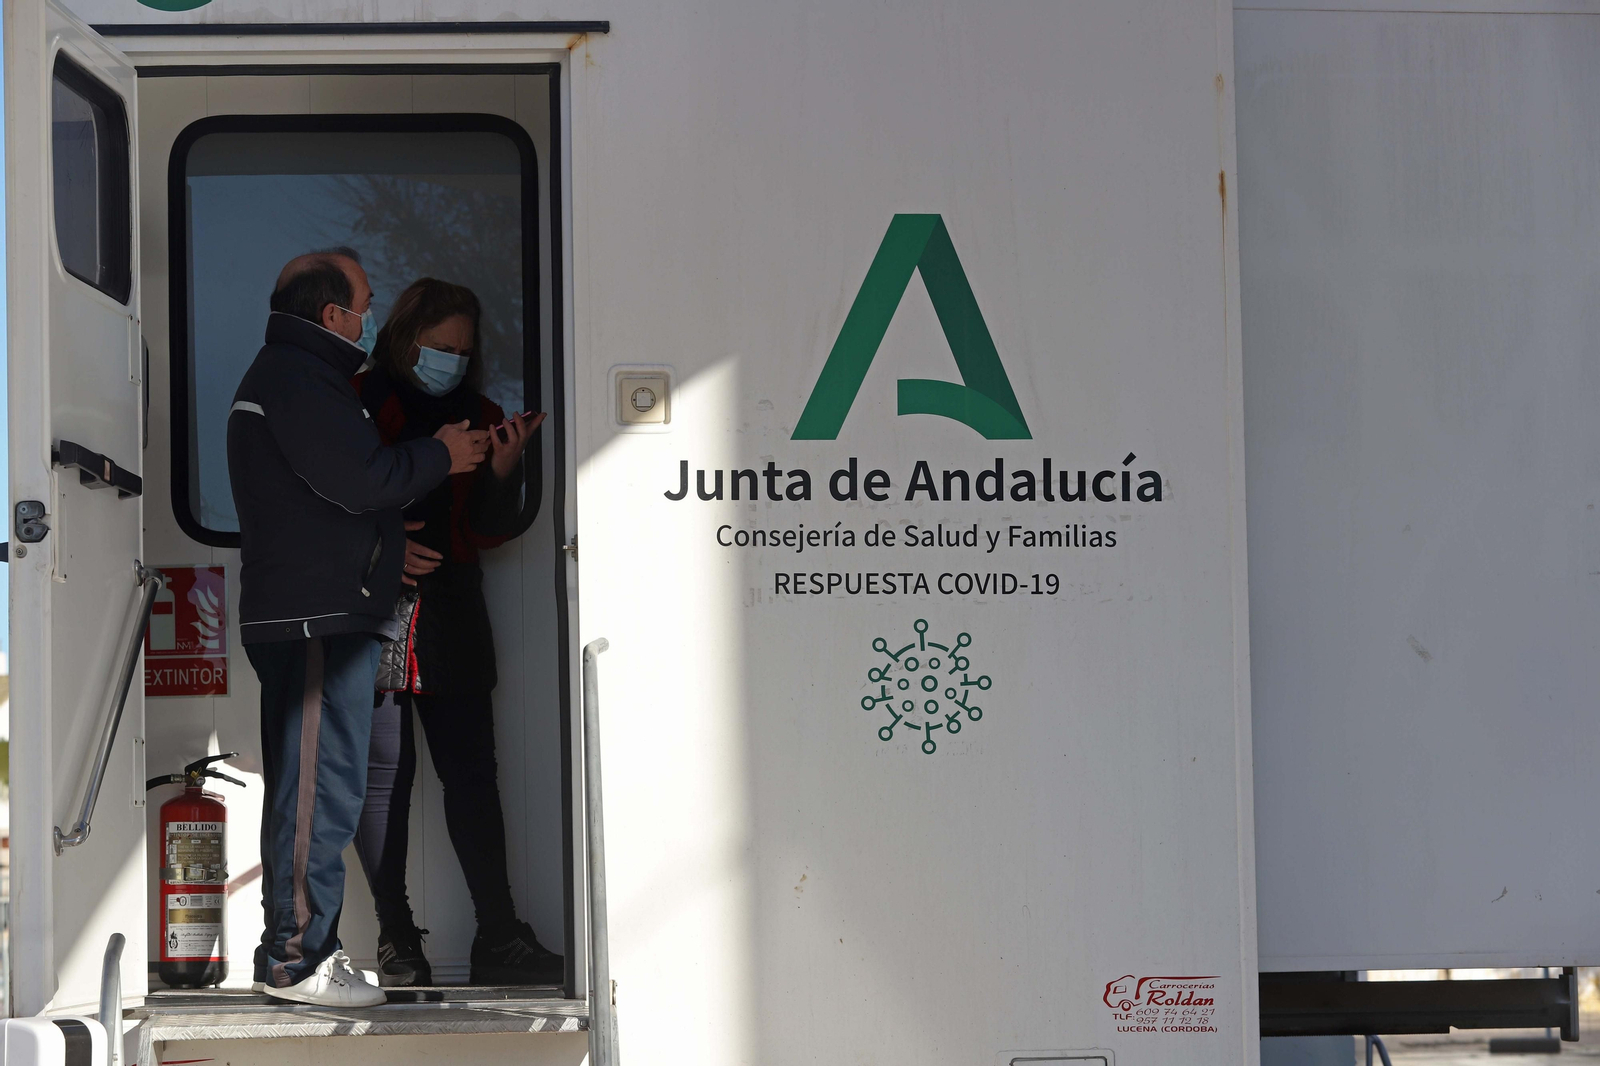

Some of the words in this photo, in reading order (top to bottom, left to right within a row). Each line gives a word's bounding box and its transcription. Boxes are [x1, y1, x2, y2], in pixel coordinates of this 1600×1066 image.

[664, 460, 812, 502] Junta
[829, 457, 891, 502] de
[904, 451, 1163, 503] Andalucía
[716, 520, 856, 554] Consejería
[864, 523, 896, 547] de
[903, 523, 978, 548] Salud
[985, 530, 1001, 554] y
[1008, 523, 1117, 548] Familias
[774, 572, 931, 595] RESPUESTA
[937, 572, 1060, 596] COVID-19
[144, 667, 224, 686] EXTINTOR
[176, 823, 217, 831] BELLIDO
[1146, 989, 1215, 1006] Roldan
[1112, 1013, 1135, 1021] TLF:
[1136, 1008, 1160, 1016] 609
[1163, 1008, 1178, 1016] 74
[1181, 1008, 1198, 1016] 64
[1201, 1008, 1216, 1016] 21
[1136, 1016, 1159, 1025] 957
[1162, 1016, 1175, 1025] 11
[1179, 1016, 1192, 1025] 12
[1196, 1016, 1210, 1025] 18
[1161, 1025, 1218, 1034] (CORDOBA)
